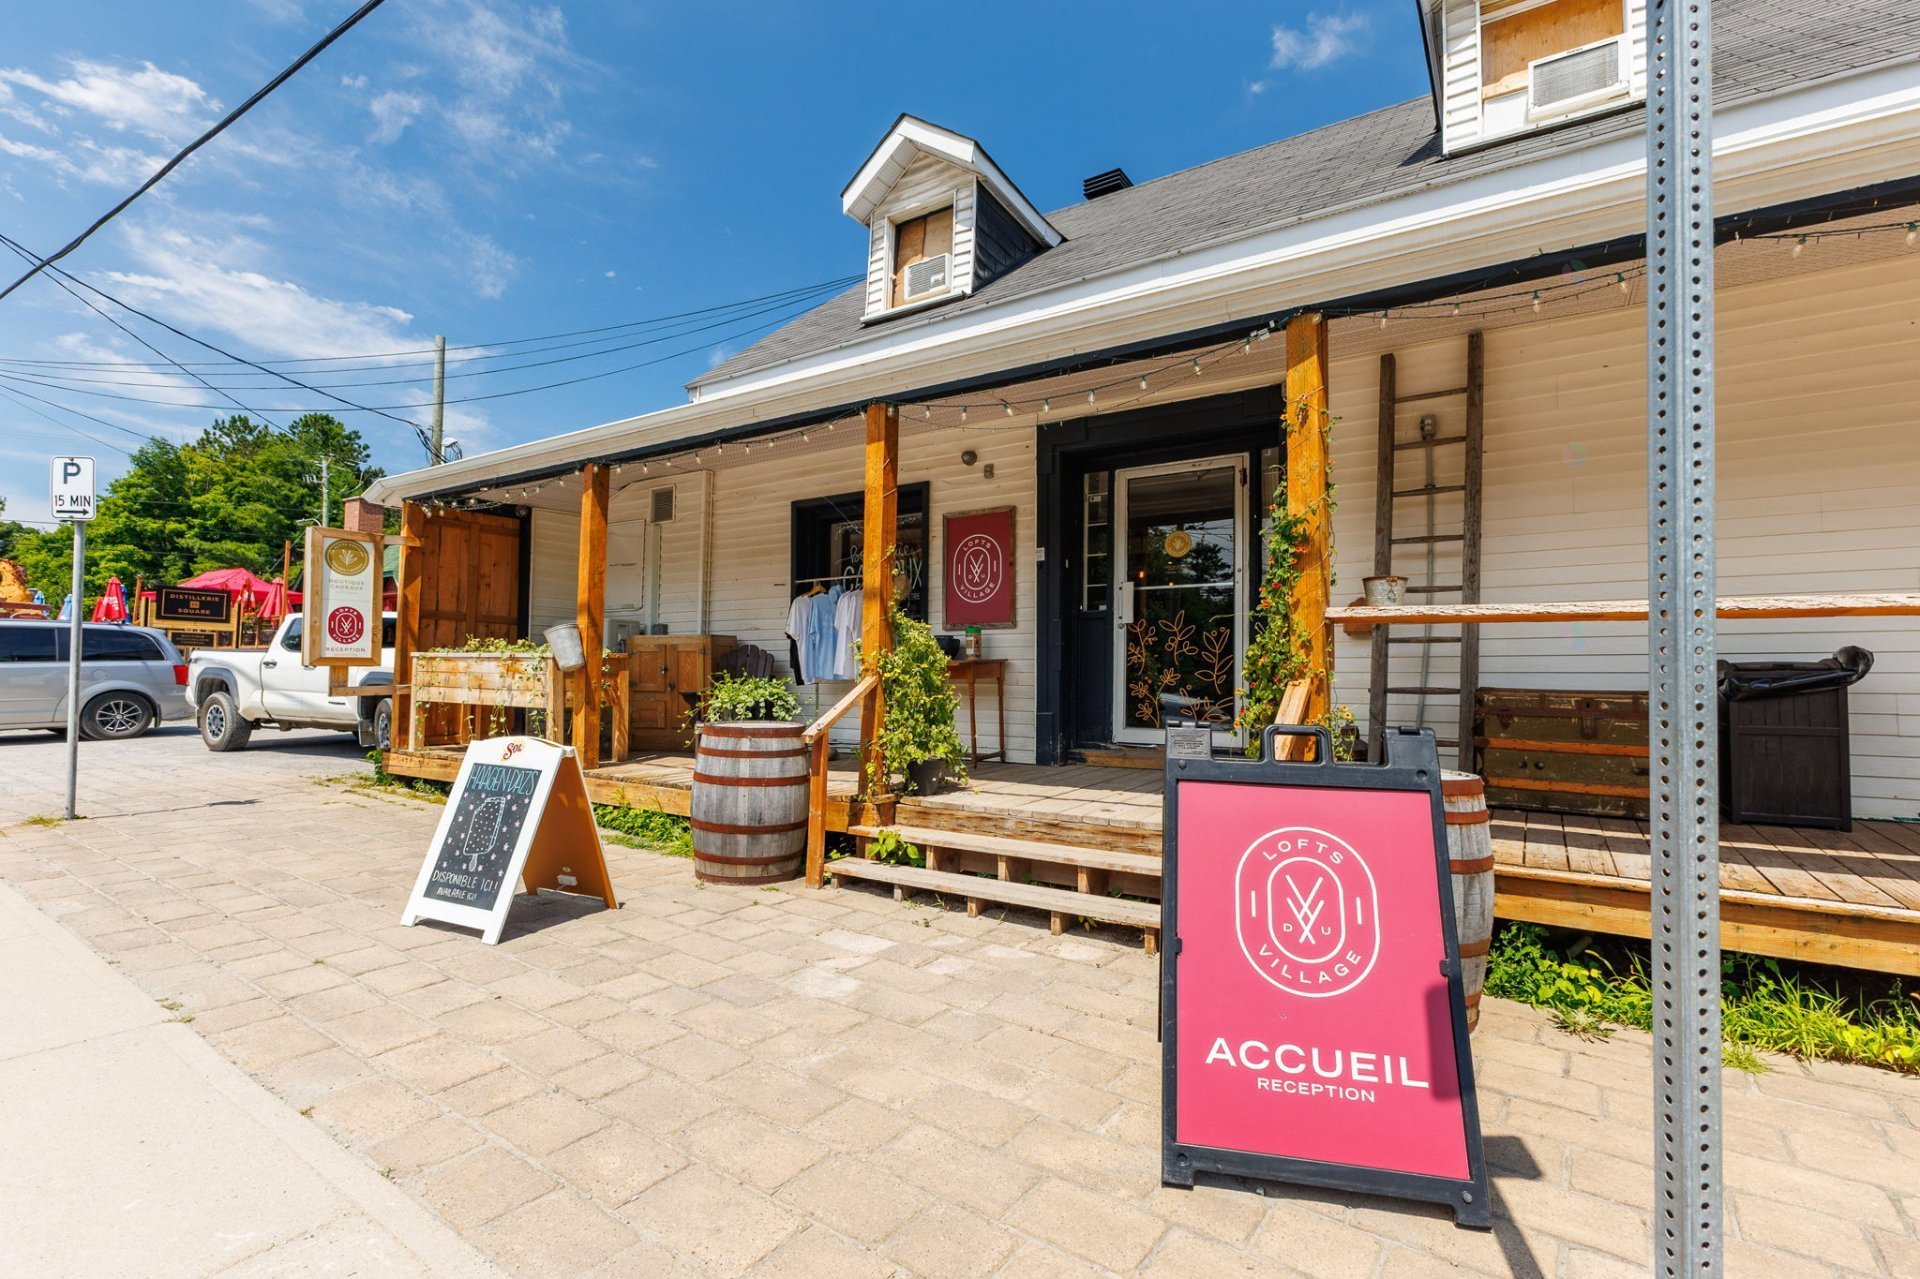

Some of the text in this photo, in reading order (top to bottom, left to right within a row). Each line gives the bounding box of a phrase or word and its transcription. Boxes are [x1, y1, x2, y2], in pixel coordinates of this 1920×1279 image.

[63, 462, 81, 484] P
[54, 494, 91, 507] 15 MIN
[963, 540, 991, 551] LOFTS
[170, 593, 219, 601] DISTILLERIE
[960, 582, 995, 598] VILLAGE
[332, 633, 360, 643] VILLAGE
[1262, 838, 1344, 865] LOFTS
[432, 869, 479, 889] DISPONIBLE
[1259, 943, 1362, 984] VILLAGE
[1205, 1037, 1430, 1089] ACCUEIL
[1257, 1077, 1376, 1103] RECEPTION
